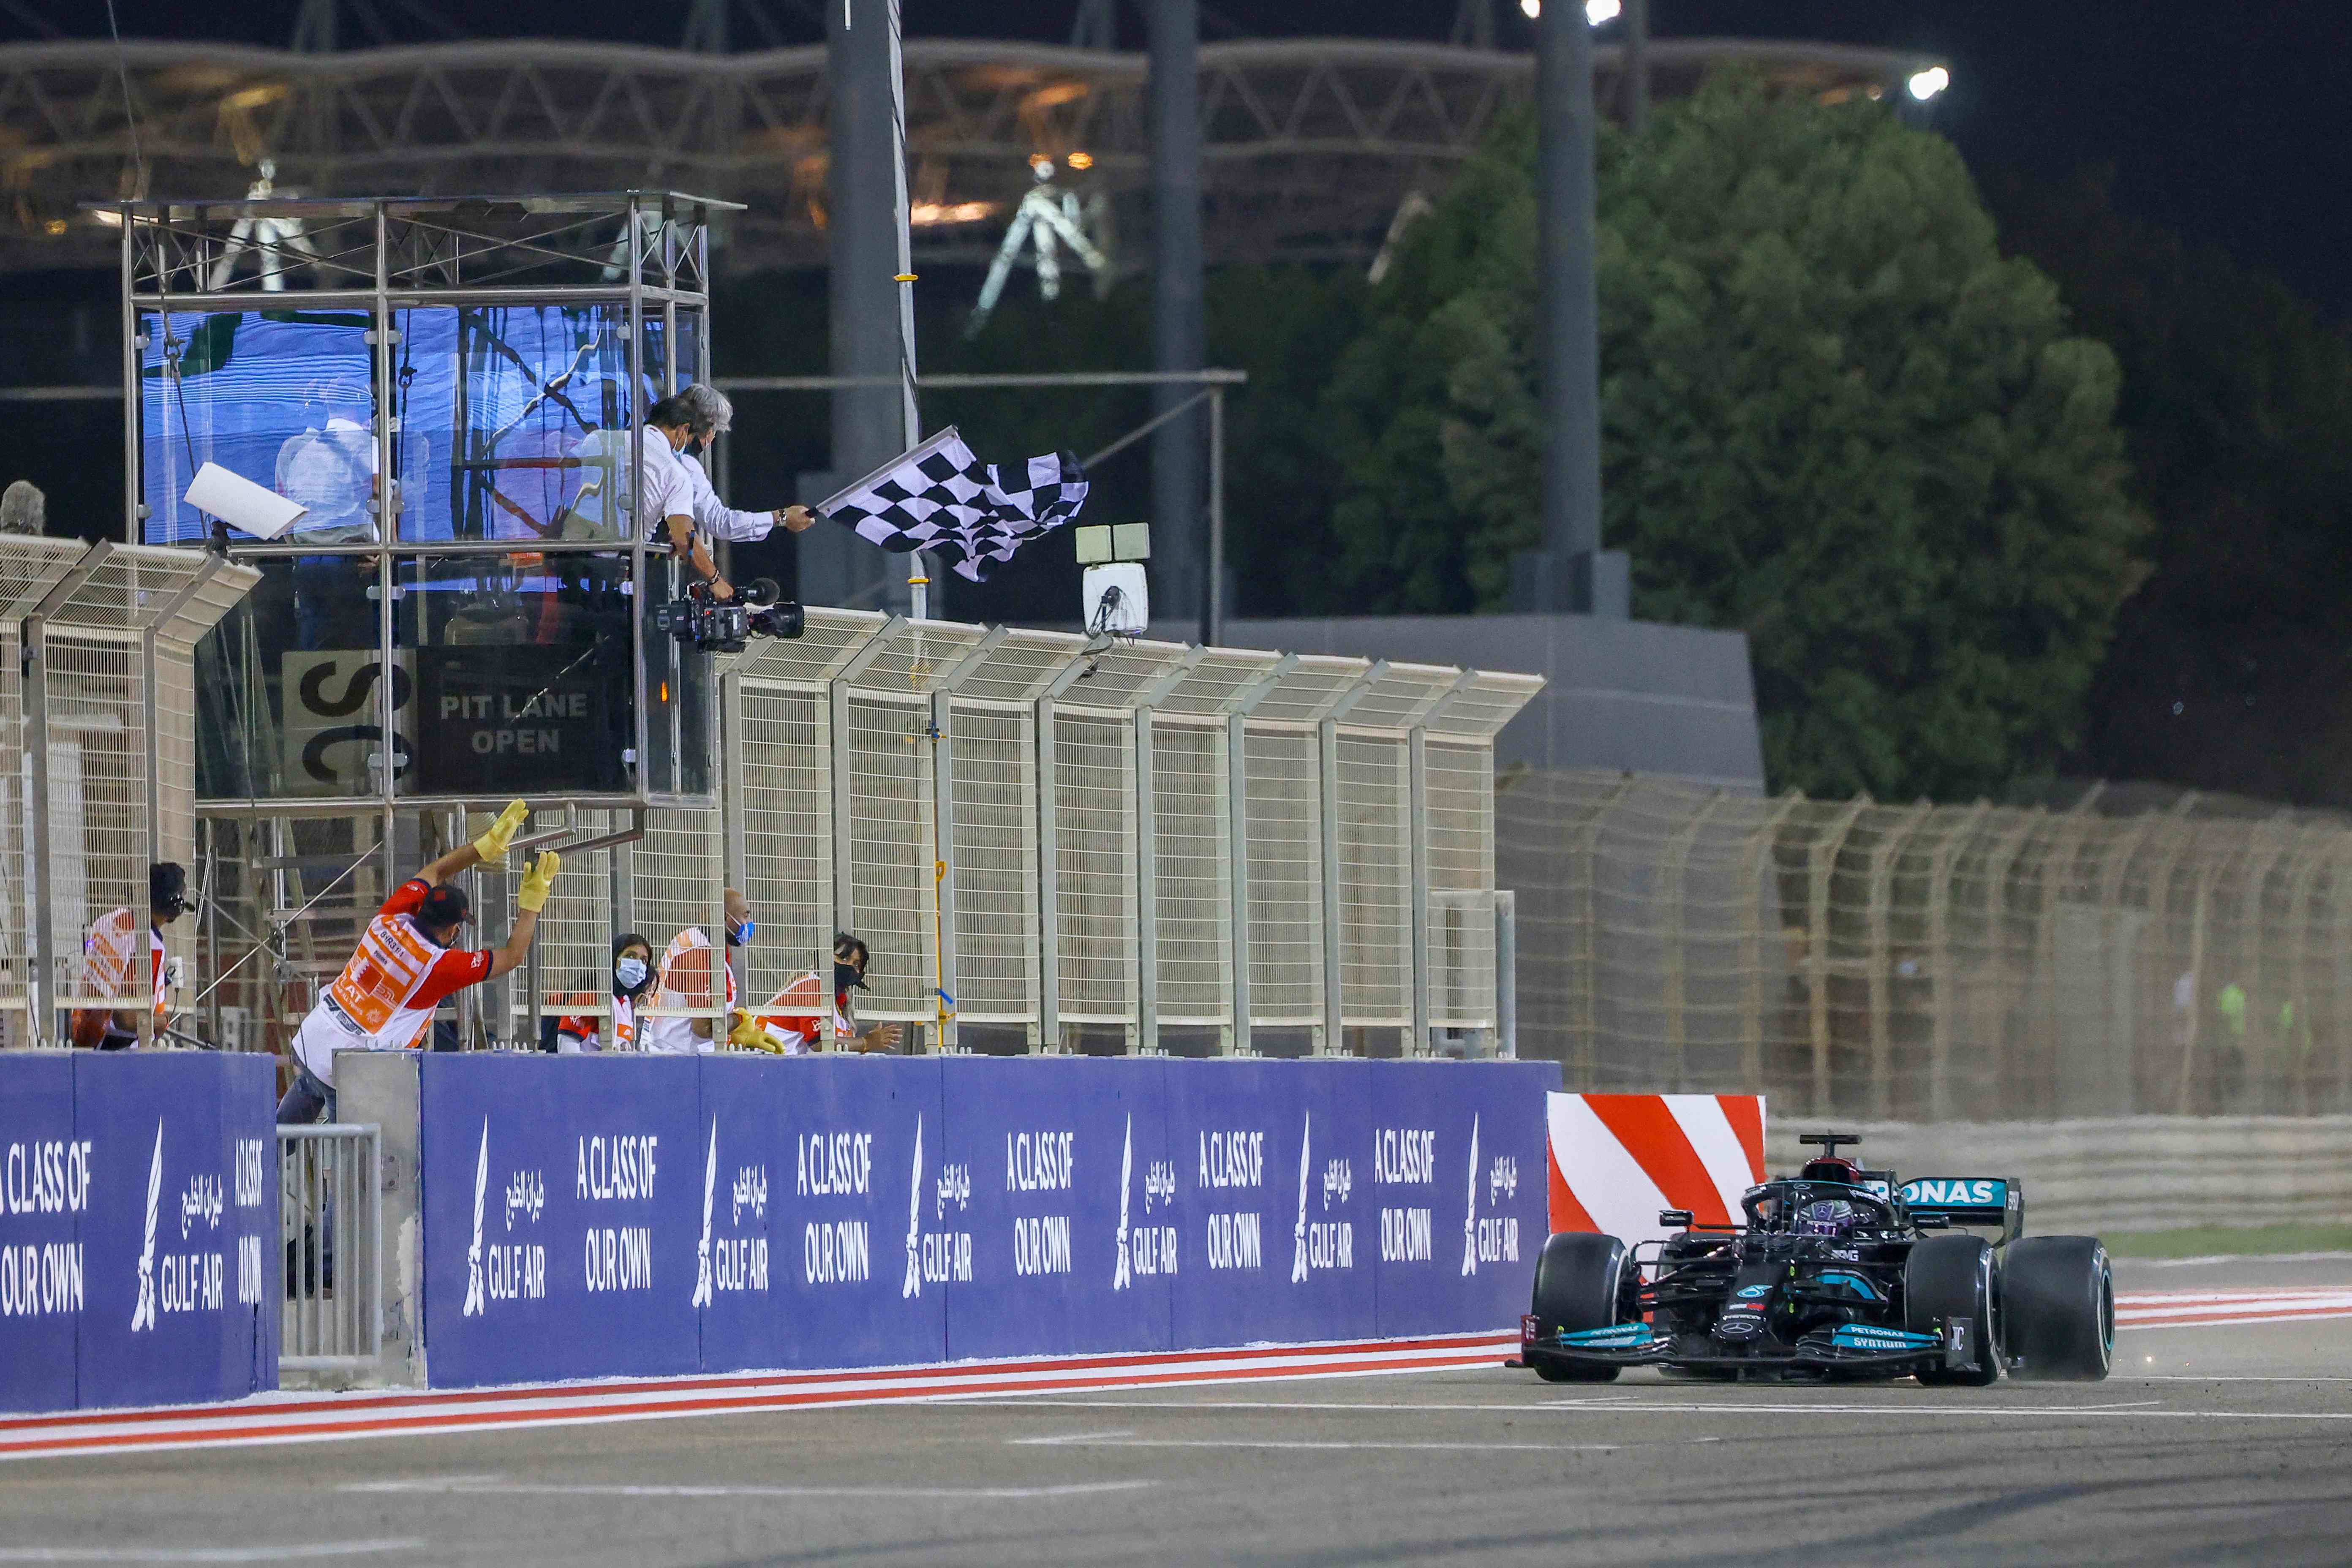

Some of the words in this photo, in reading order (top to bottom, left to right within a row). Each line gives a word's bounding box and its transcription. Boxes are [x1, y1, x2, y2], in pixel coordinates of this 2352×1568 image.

[441, 695, 492, 720] PIT
[503, 693, 588, 719] LANE
[472, 729, 560, 754] OPEN
[8, 1141, 64, 1214] CLASS
[68, 1141, 91, 1211] OF
[577, 1135, 588, 1200] A
[590, 1135, 637, 1200] CLASS
[640, 1135, 657, 1199] OF
[798, 1134, 808, 1196] A
[810, 1132, 852, 1195] CLASS
[854, 1133, 872, 1194] OF
[1007, 1132, 1016, 1192] A
[1017, 1132, 1057, 1191] CLASS
[1058, 1132, 1073, 1190] OF
[1200, 1131, 1209, 1188] A
[1211, 1131, 1248, 1188] CLASS
[1249, 1132, 1263, 1187] OF
[1375, 1129, 1383, 1184] A
[1384, 1129, 1420, 1184] CLASS
[1421, 1130, 1435, 1184] OF
[585, 1228, 617, 1292] OUR
[620, 1227, 651, 1290] OWN
[805, 1222, 834, 1284] OUR
[836, 1220, 869, 1282] OWN
[923, 1233, 952, 1282] GULF
[953, 1232, 972, 1282] AIR
[1015, 1217, 1041, 1276] OUR
[1042, 1216, 1071, 1274] OWN
[1133, 1227, 1158, 1275] GULF
[1161, 1226, 1178, 1274] AIR
[1208, 1212, 1233, 1269] OUR
[1233, 1212, 1261, 1269] OWN
[1309, 1222, 1335, 1269] GULF
[1337, 1222, 1353, 1269] AIR
[1381, 1208, 1405, 1262] OUR
[1406, 1207, 1431, 1261] OWN
[1478, 1218, 1502, 1262] GULF
[1503, 1217, 1519, 1262] AIR
[2, 1246, 38, 1316] OUR
[43, 1243, 83, 1313] OWN
[161, 1255, 199, 1312] GULF
[202, 1252, 223, 1311] AIR
[489, 1244, 522, 1299] GULF
[524, 1244, 545, 1299] AIR
[716, 1238, 748, 1290] GULF
[749, 1238, 768, 1291] AIR
[1851, 1326, 1905, 1337] PETRONAS
